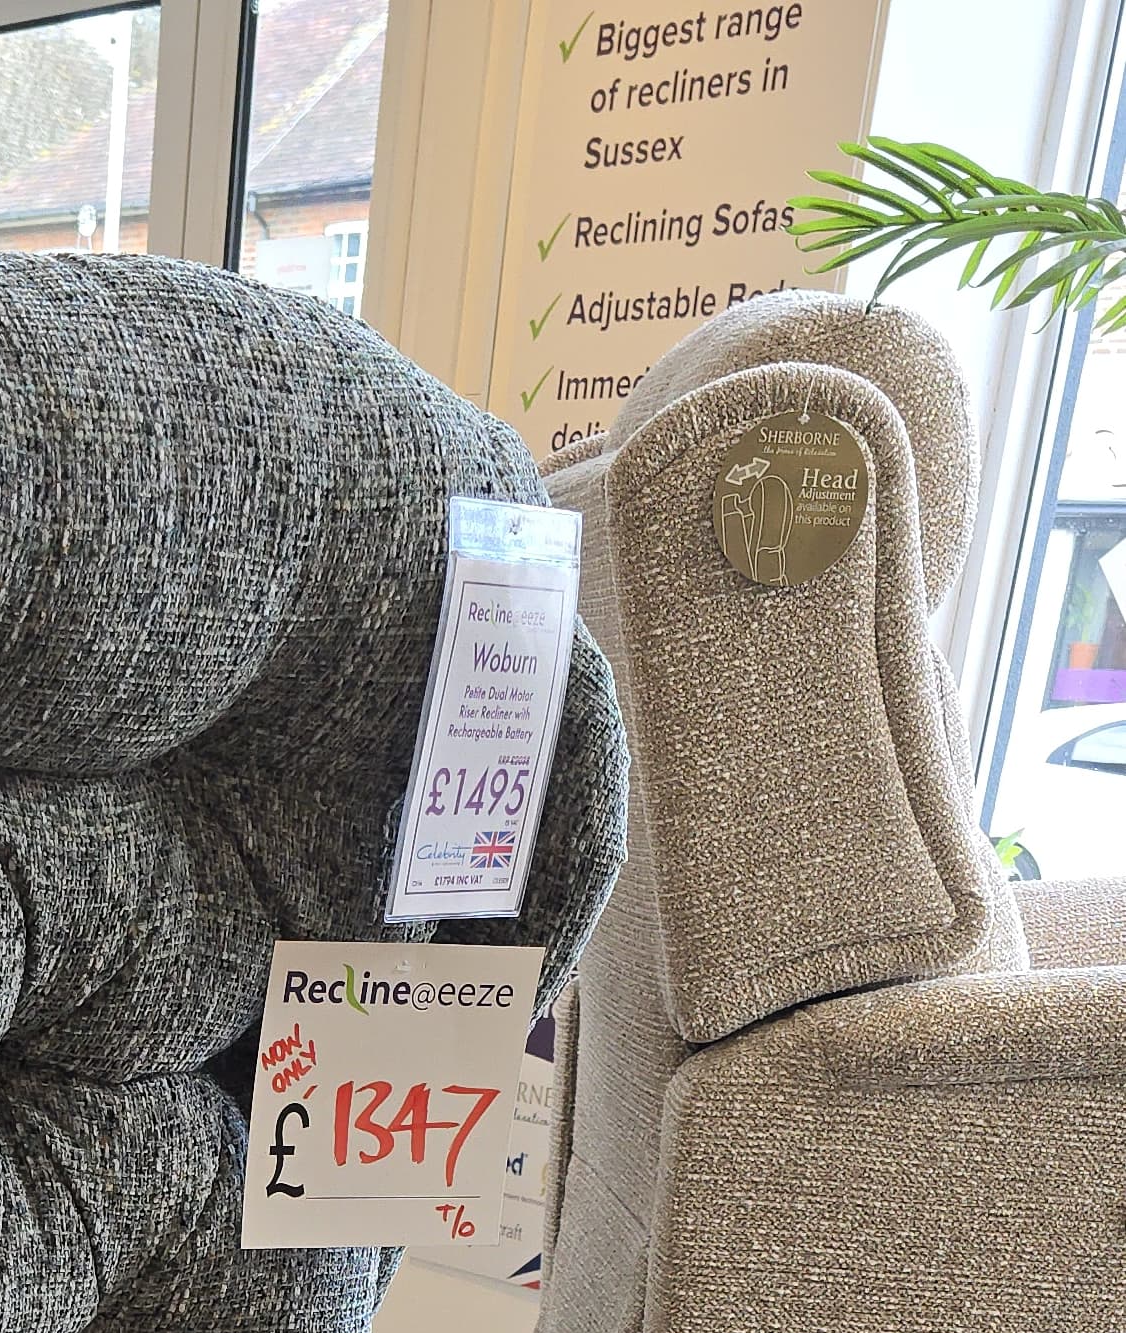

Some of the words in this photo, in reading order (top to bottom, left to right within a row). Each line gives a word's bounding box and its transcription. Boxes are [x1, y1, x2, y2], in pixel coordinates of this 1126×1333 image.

[596, 11, 706, 61] Biggest
[715, 3, 803, 41] range
[590, 77, 621, 113] of
[626, 68, 751, 110] recliners
[762, 57, 788, 92] in
[584, 136, 684, 169] Sussex
[575, 208, 703, 248] Reclining
[712, 200, 795, 237] Sofas
[567, 286, 716, 331] Adjustable
[759, 427, 840, 446] SHERBORNE
[801, 468, 858, 489] Head
[796, 501, 837, 512] available
[839, 505, 851, 513] on
[798, 487, 855, 500] Adjustment
[795, 512, 811, 525] this
[813, 515, 850, 527] product
[474, 640, 537, 674] Woburn
[464, 685, 486, 699] Petite
[488, 685, 508, 701] Dual
[509, 687, 534, 702] Motor
[459, 704, 479, 718] Riser
[481, 705, 513, 720] Recliner
[515, 706, 530, 720] with
[447, 722, 503, 741] Rechargeable
[505, 725, 533, 744] Battery
[425, 766, 530, 816] £1495
[417, 841, 471, 865] Celebrity
[434, 875, 455, 886] £1794
[456, 874, 470, 885] INC
[471, 874, 483, 885] VAT
[261, 1023, 302, 1070] NOW
[272, 1040, 317, 1093] ONLY
[334, 1080, 501, 1188] 1347
